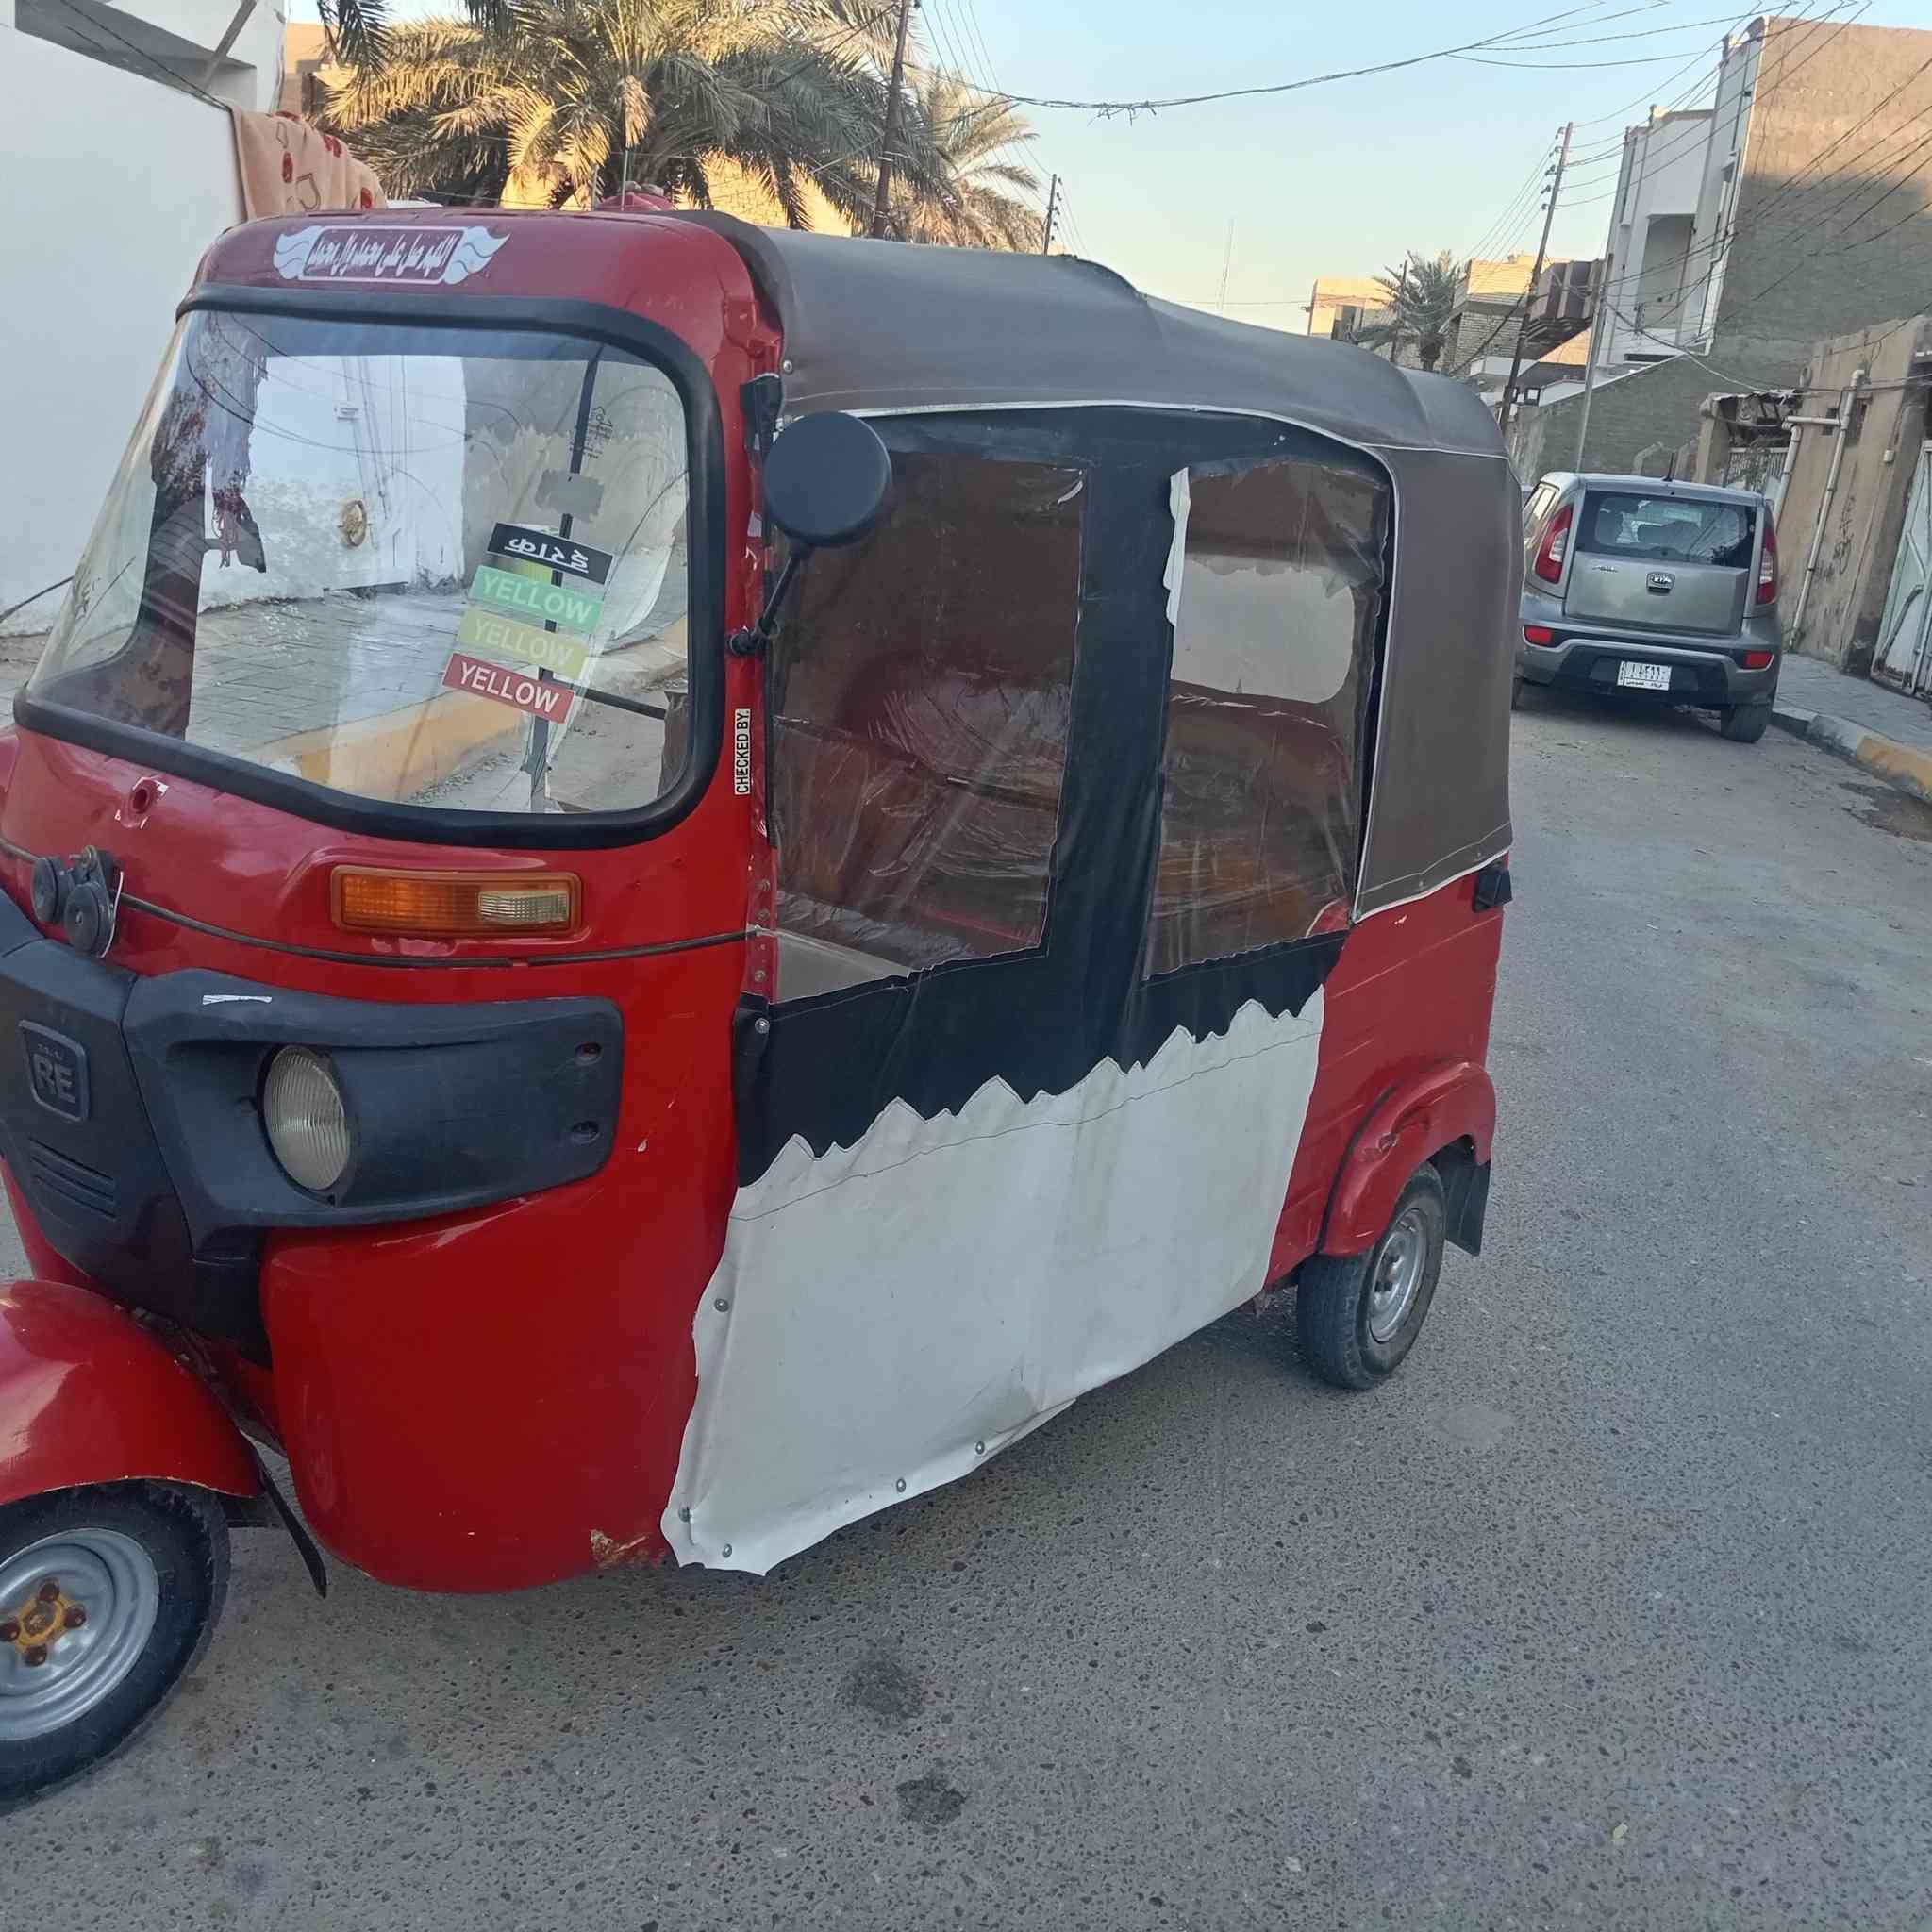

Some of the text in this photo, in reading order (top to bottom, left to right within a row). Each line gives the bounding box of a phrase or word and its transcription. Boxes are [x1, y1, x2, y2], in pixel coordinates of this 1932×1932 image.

[504, 539, 589, 573] इराक
[483, 571, 592, 623] YELLOW
[475, 619, 574, 664] YELLOW
[460, 662, 559, 713] YELLOW
[736, 733, 749, 793] CHECKED
[32, 1053, 76, 1104] RE
